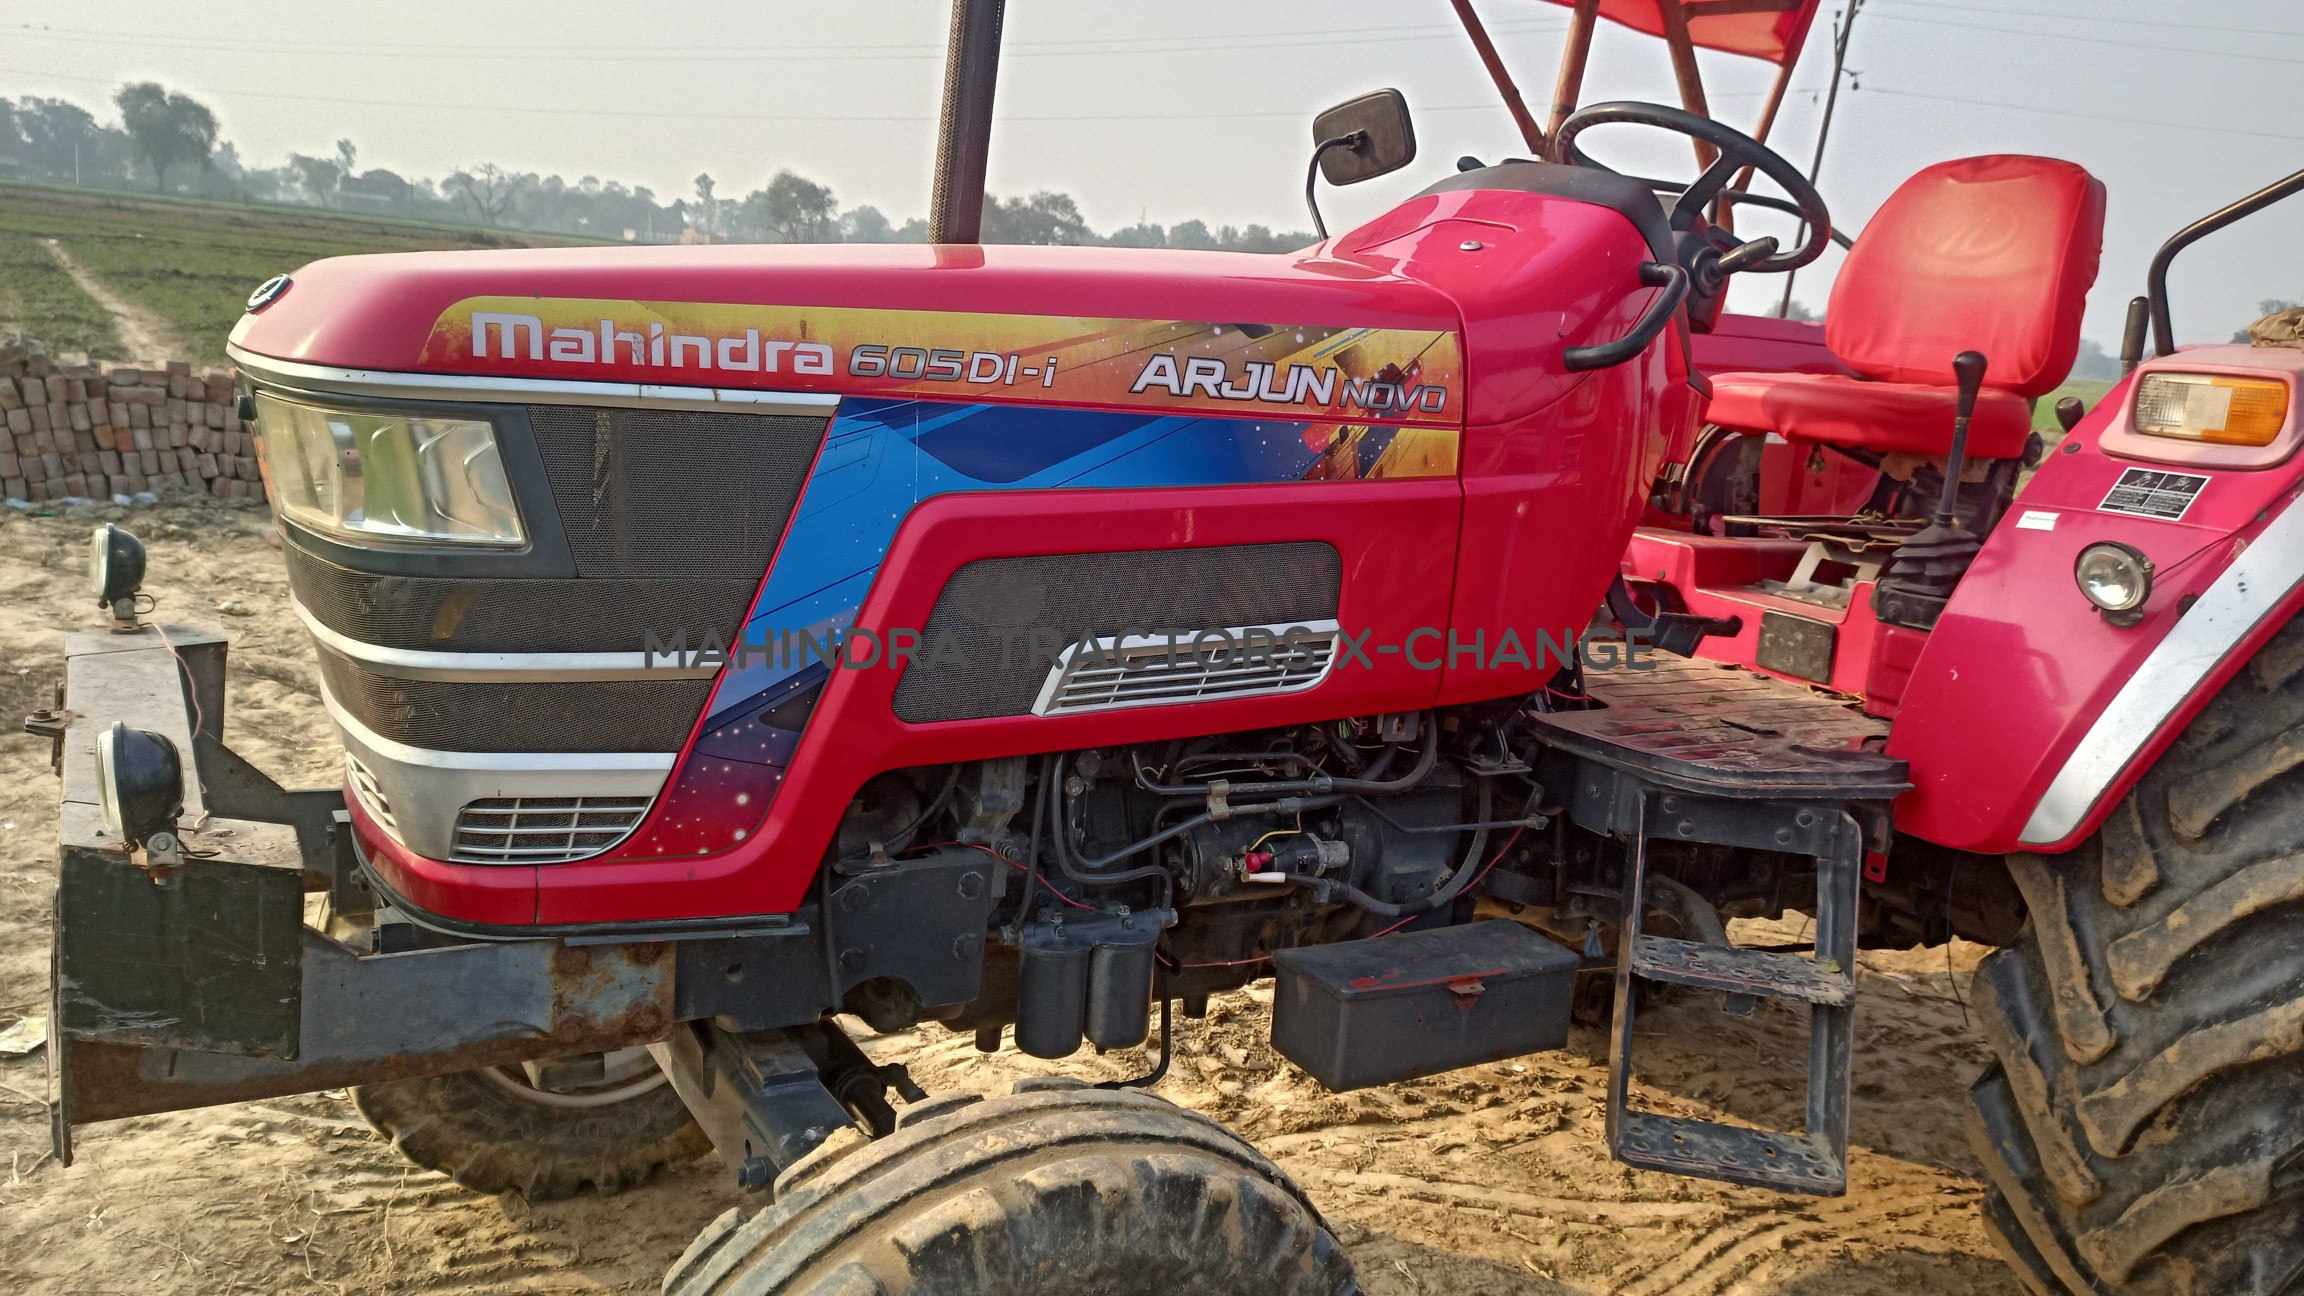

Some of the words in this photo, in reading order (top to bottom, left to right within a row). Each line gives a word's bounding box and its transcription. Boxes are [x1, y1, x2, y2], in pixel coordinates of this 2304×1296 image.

[472, 312, 834, 375] Mahindra
[1128, 353, 1337, 406] ARJUN
[1339, 379, 1446, 413] NOVO
